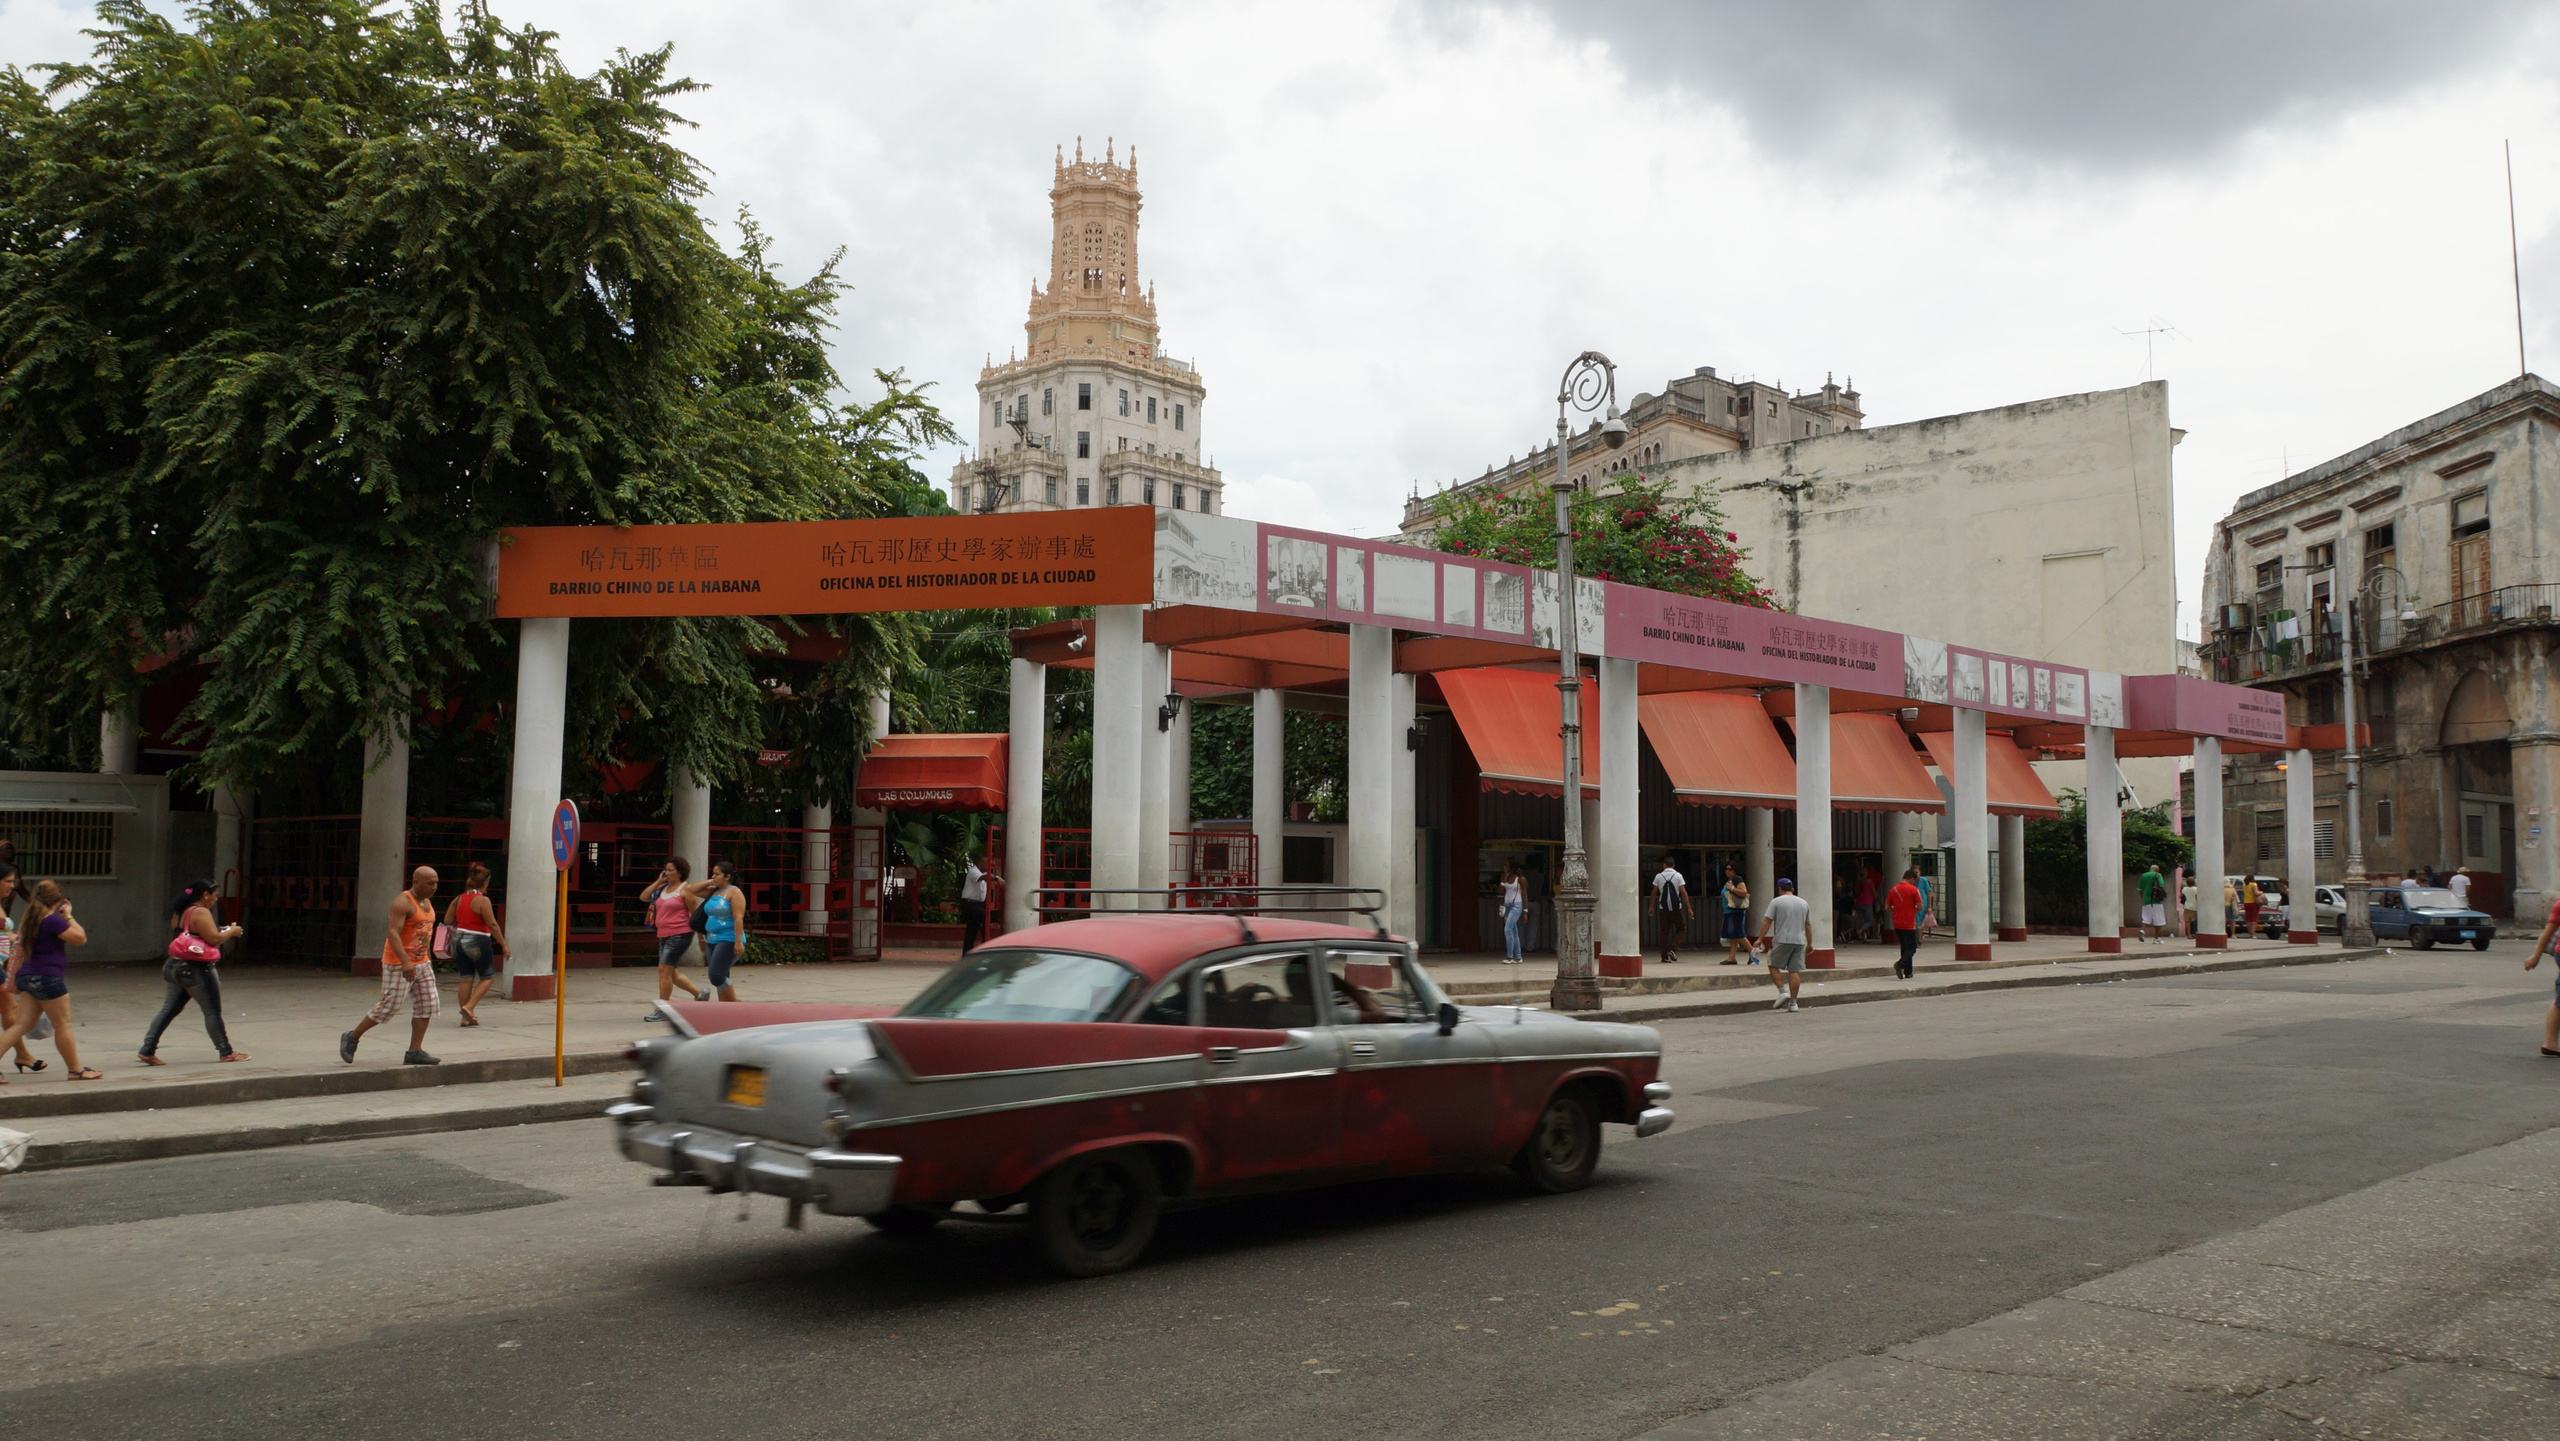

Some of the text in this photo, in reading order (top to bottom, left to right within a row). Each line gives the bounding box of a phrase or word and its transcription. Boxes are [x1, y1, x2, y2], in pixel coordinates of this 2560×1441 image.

[580, 545, 720, 573] 哈瓦那華區
[822, 534, 1096, 567] 哈瓦那歷史學家辦事處
[549, 580, 762, 595] BARRIO CHINO DE LA HABANA
[820, 569, 1096, 590] OFICINA DEL HISTORIADOR DE LA CIUDAD
[1643, 626, 1745, 652] BARRIO CHINO DE LA HABANA
[1762, 645, 1876, 671] OFICINA DEL HISTORIADOR DE LA CIUDAD
[878, 790, 953, 800] LAS COLUMNAS
